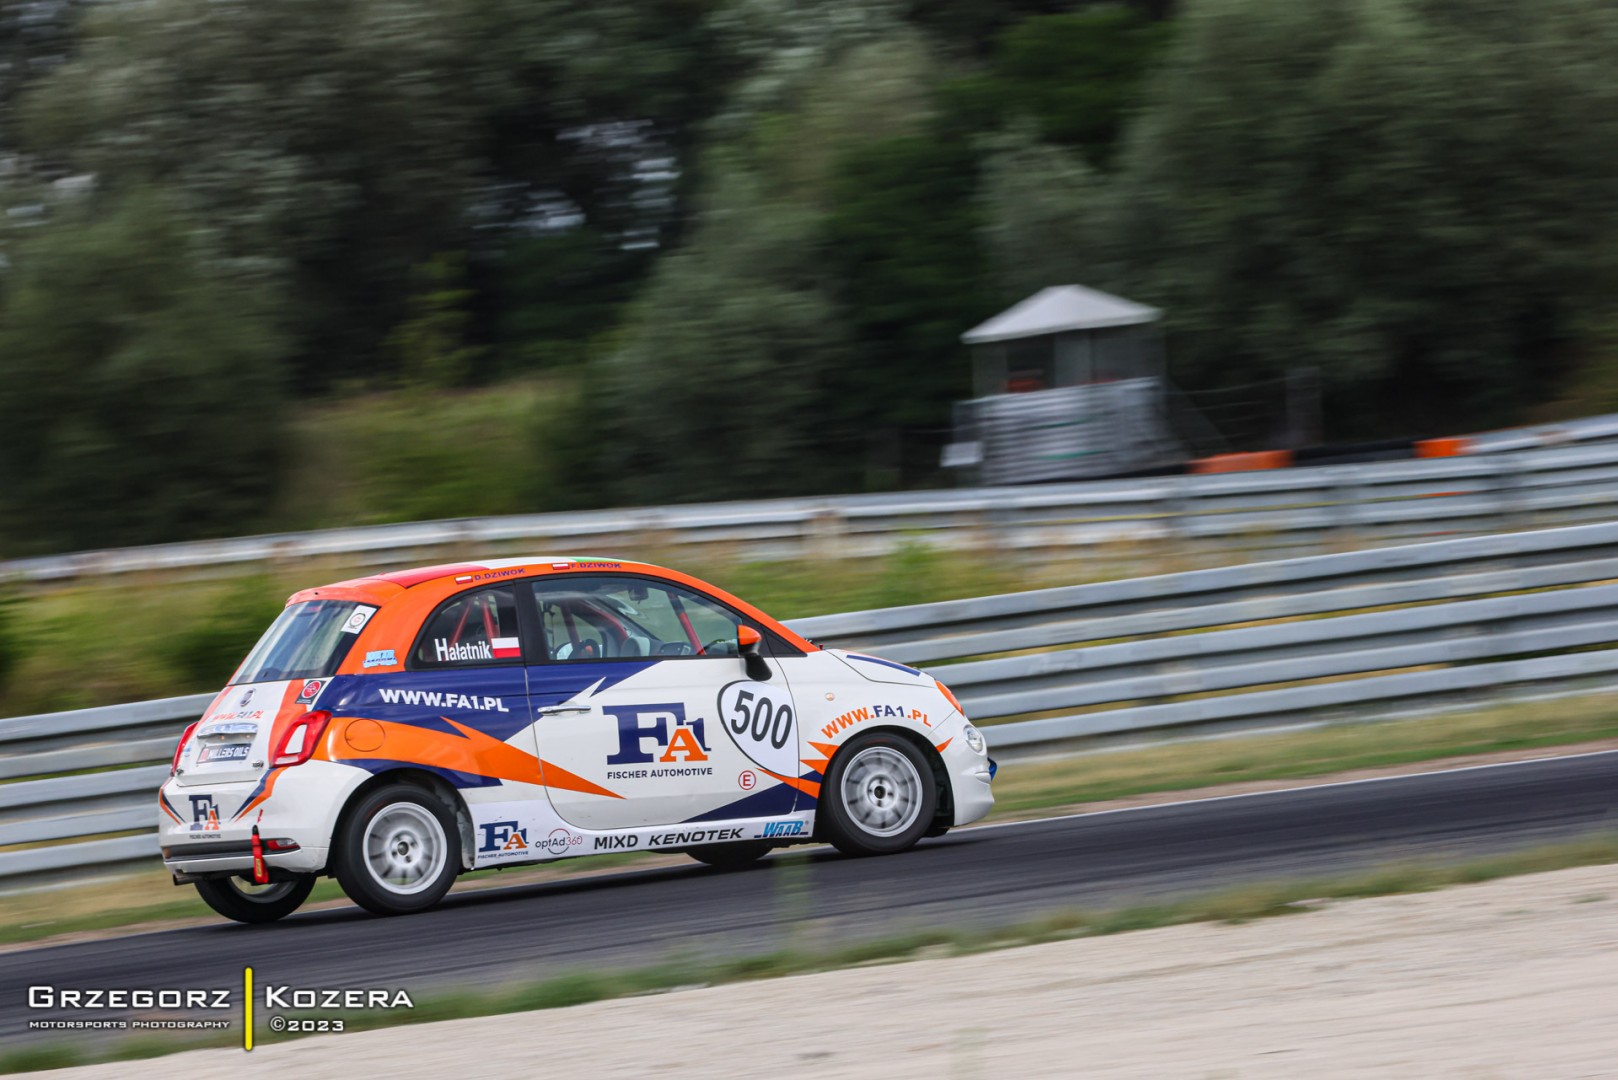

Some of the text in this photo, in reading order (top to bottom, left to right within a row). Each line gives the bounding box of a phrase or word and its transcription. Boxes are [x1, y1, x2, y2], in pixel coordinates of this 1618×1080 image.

[474, 568, 525, 580] D.DZIWOK
[434, 638, 492, 661] Hałatnik
[379, 688, 509, 712] WWW.FA1.PL
[731, 689, 792, 749] 500
[820, 704, 932, 739] WWW.FA1.PL
[607, 767, 713, 779] FISCHER AUTOMOTIVE
[742, 774, 752, 787] E
[535, 835, 583, 850] optAd360
[594, 834, 639, 850] MIXD
[648, 827, 744, 846] KENOTEK
[498, 850, 529, 858] AUTOMOTIVE
